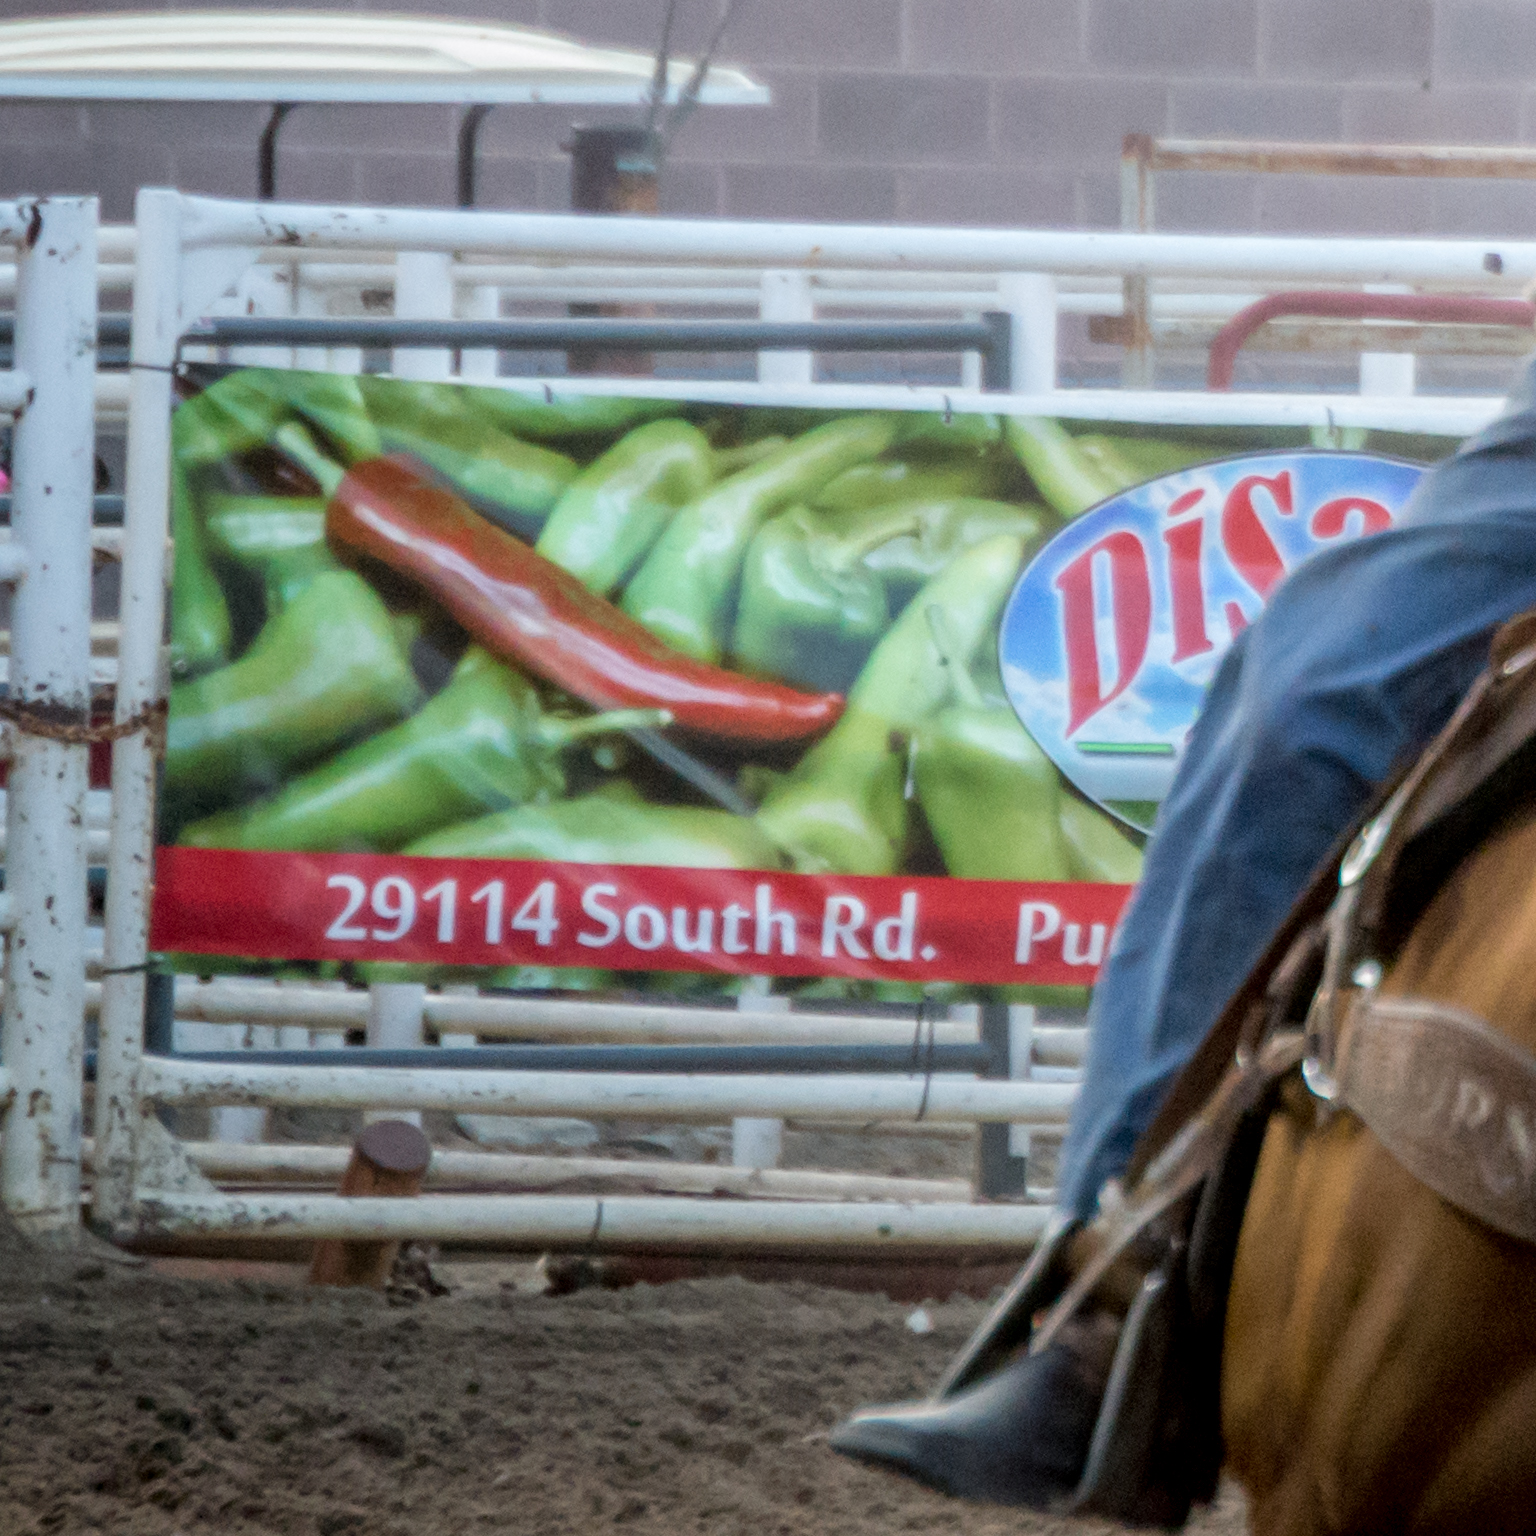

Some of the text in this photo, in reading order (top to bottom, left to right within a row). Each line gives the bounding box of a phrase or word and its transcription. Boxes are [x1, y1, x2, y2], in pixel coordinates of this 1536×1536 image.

[325, 874, 560, 946] 29114
[577, 884, 797, 956] South
[821, 892, 937, 962] Rd.
